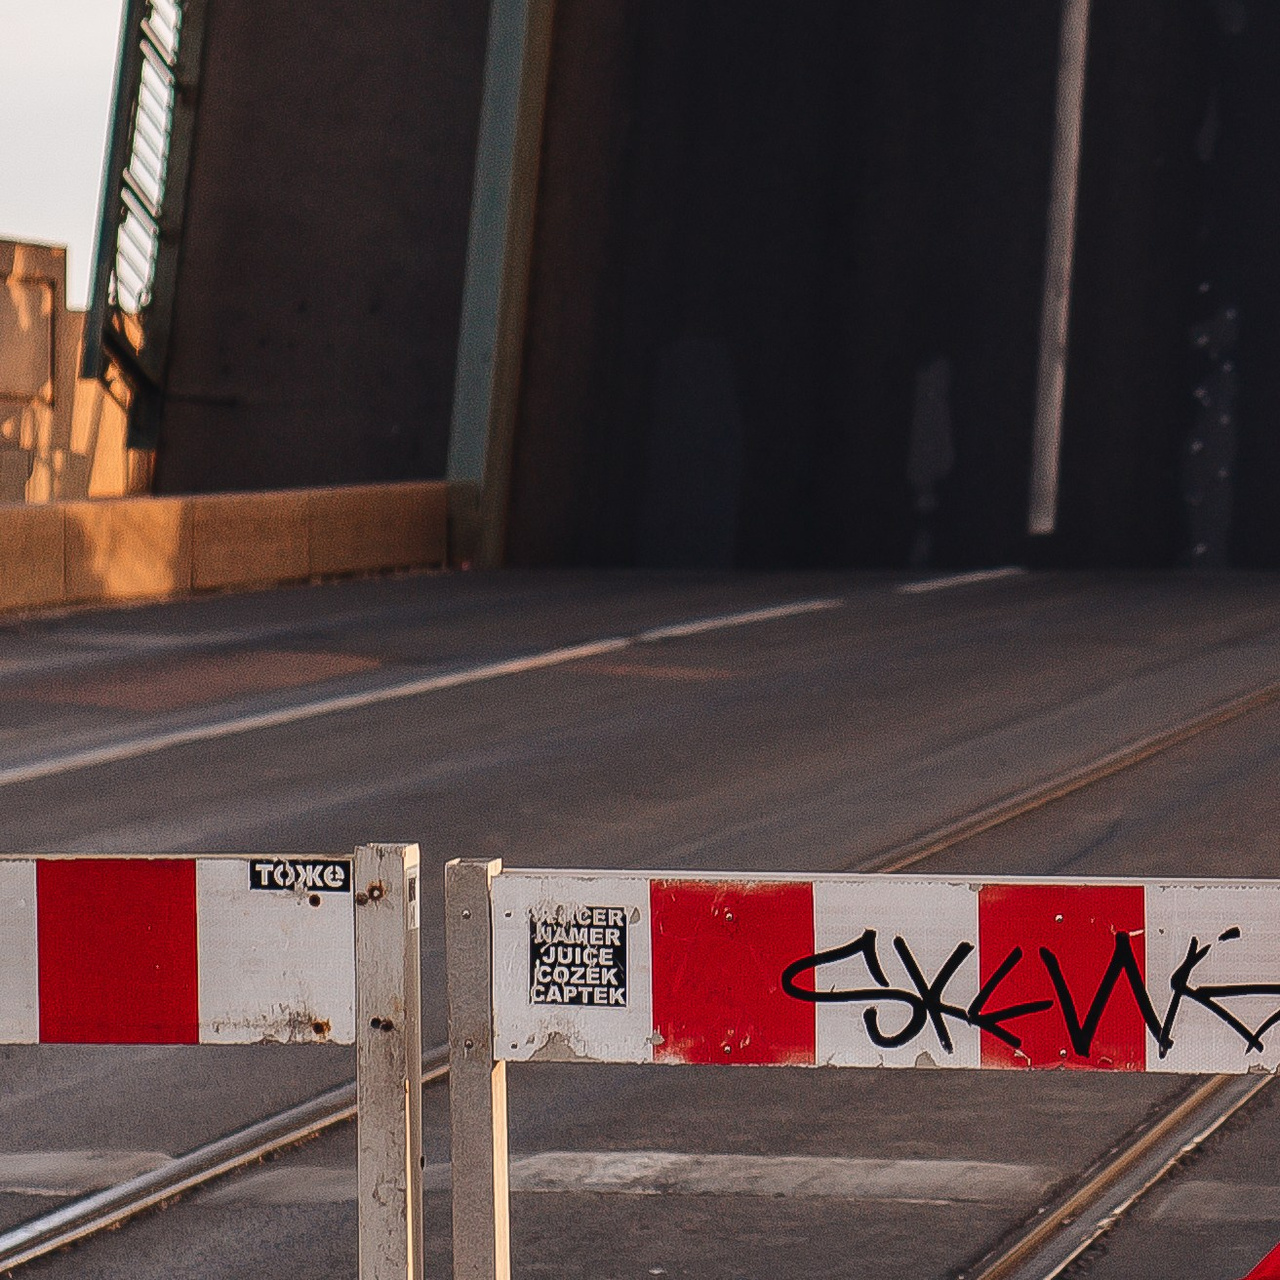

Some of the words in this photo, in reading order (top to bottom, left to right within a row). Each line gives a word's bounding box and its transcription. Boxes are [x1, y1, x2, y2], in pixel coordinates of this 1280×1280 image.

[541, 946, 615, 966] JUICE
[537, 965, 619, 986] COZEK
[531, 985, 626, 1005] CAPTEK
